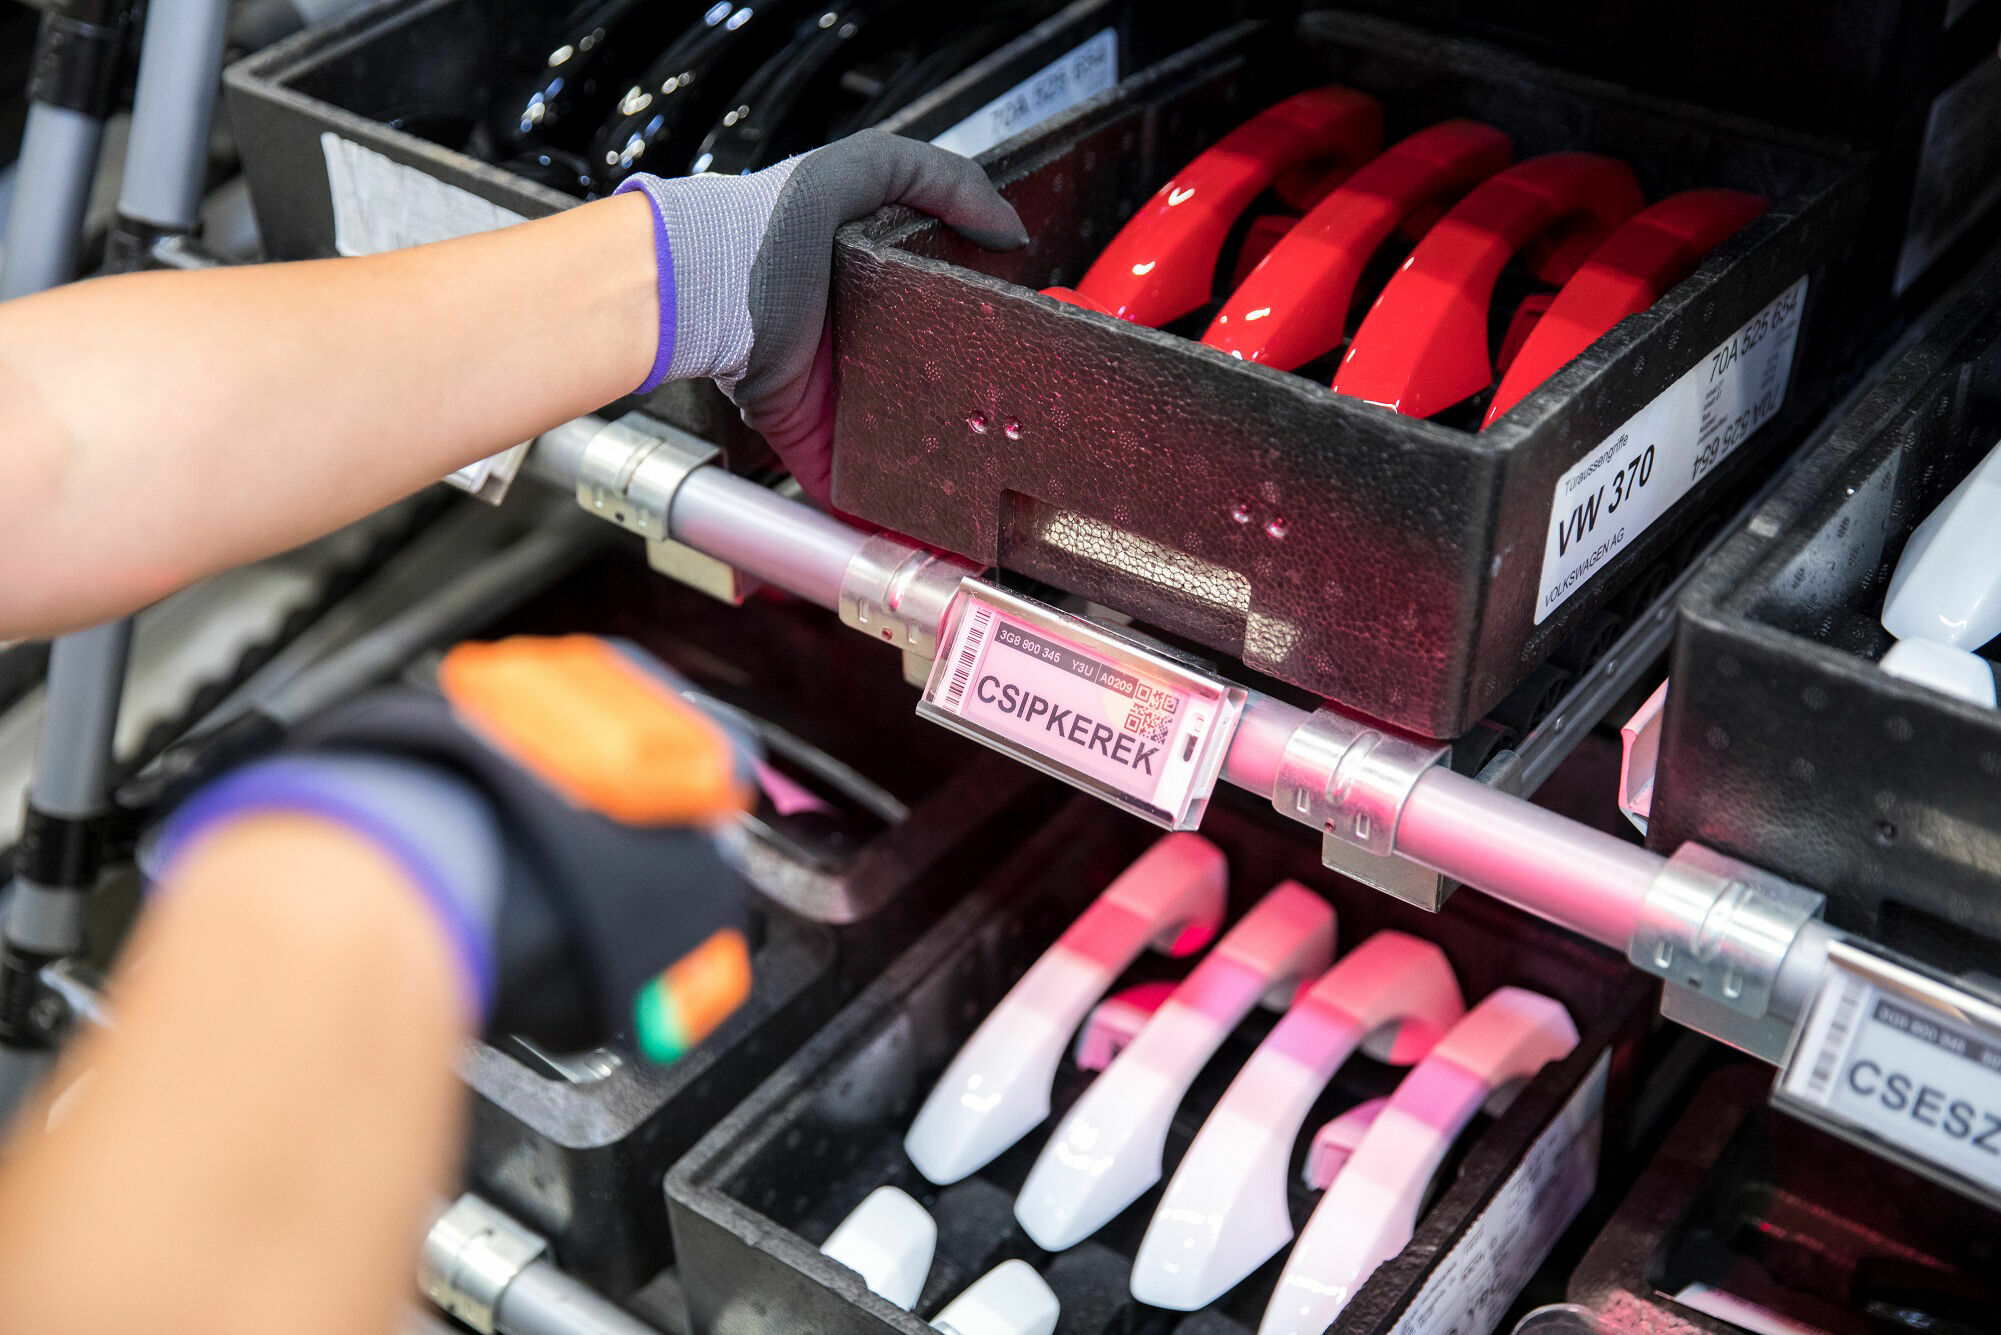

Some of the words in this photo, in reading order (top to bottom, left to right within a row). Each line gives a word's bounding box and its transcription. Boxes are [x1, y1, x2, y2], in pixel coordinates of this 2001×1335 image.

[1710, 339, 1738, 383] 70A
[1741, 313, 1769, 357] 525
[1772, 287, 1800, 330] 654
[1692, 436, 1721, 481] 654
[1722, 411, 1750, 452] 525
[1558, 484, 1605, 558] VW
[1608, 444, 1655, 515] 370
[1545, 541, 1609, 607] VOLKSWAGEN
[1609, 527, 1625, 549] AG
[1000, 630, 1021, 646] 3G8
[1022, 639, 1041, 655] 800
[1042, 647, 1061, 663] 345
[1072, 659, 1094, 677] Y3U
[1100, 672, 1133, 694] A0209
[977, 675, 1160, 776] CSIPKEREK
[1849, 1060, 2001, 1155] CSESZ
